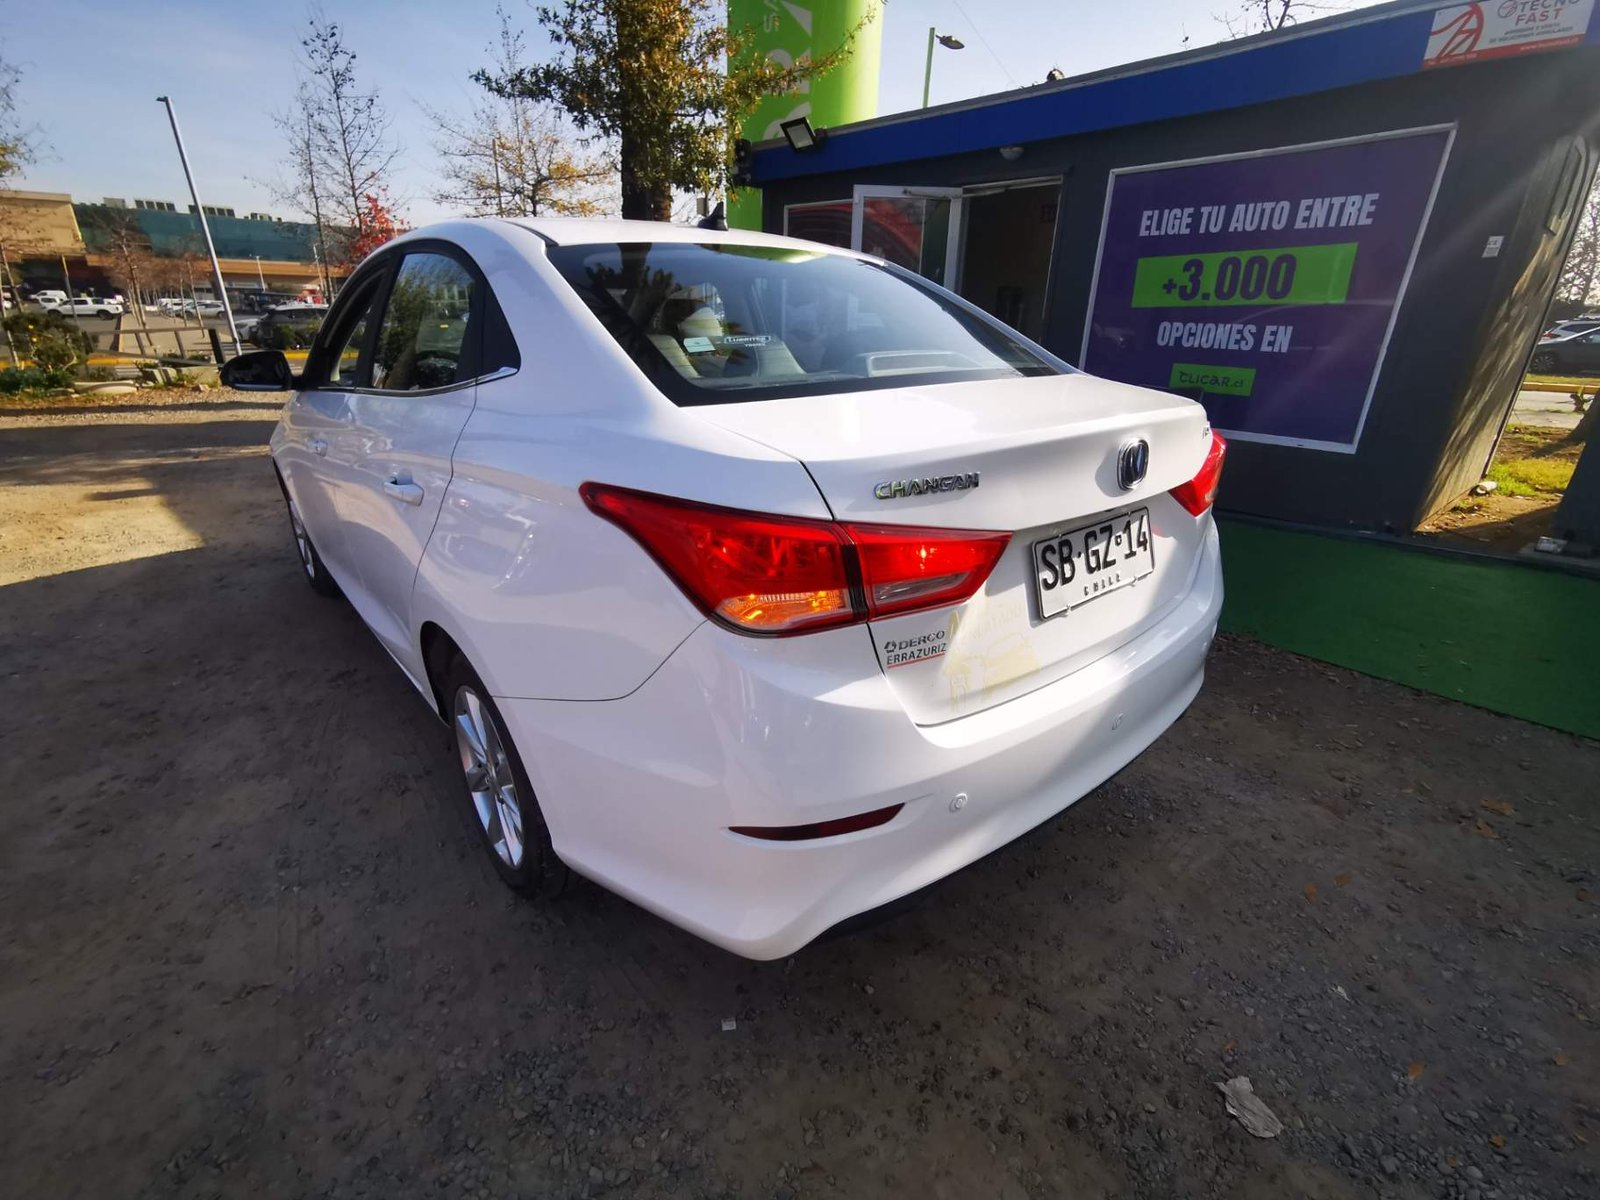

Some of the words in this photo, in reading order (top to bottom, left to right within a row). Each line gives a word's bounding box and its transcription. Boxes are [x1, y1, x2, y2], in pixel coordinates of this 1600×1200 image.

[1515, 8, 1563, 26] FAST
[1139, 207, 1194, 237] ELIGE
[1199, 205, 1227, 234] TU
[1228, 201, 1291, 233] AUTO
[1294, 193, 1380, 230] ENTRE
[1161, 253, 1298, 302] +3.000
[1156, 321, 1257, 352] OPCIONES
[1260, 325, 1294, 353] EN
[873, 472, 981, 500] CHANGAN
[1083, 573, 1121, 596] CHILE
[898, 630, 945, 651] DERCO
[886, 643, 947, 665] ERRAZURIZ
